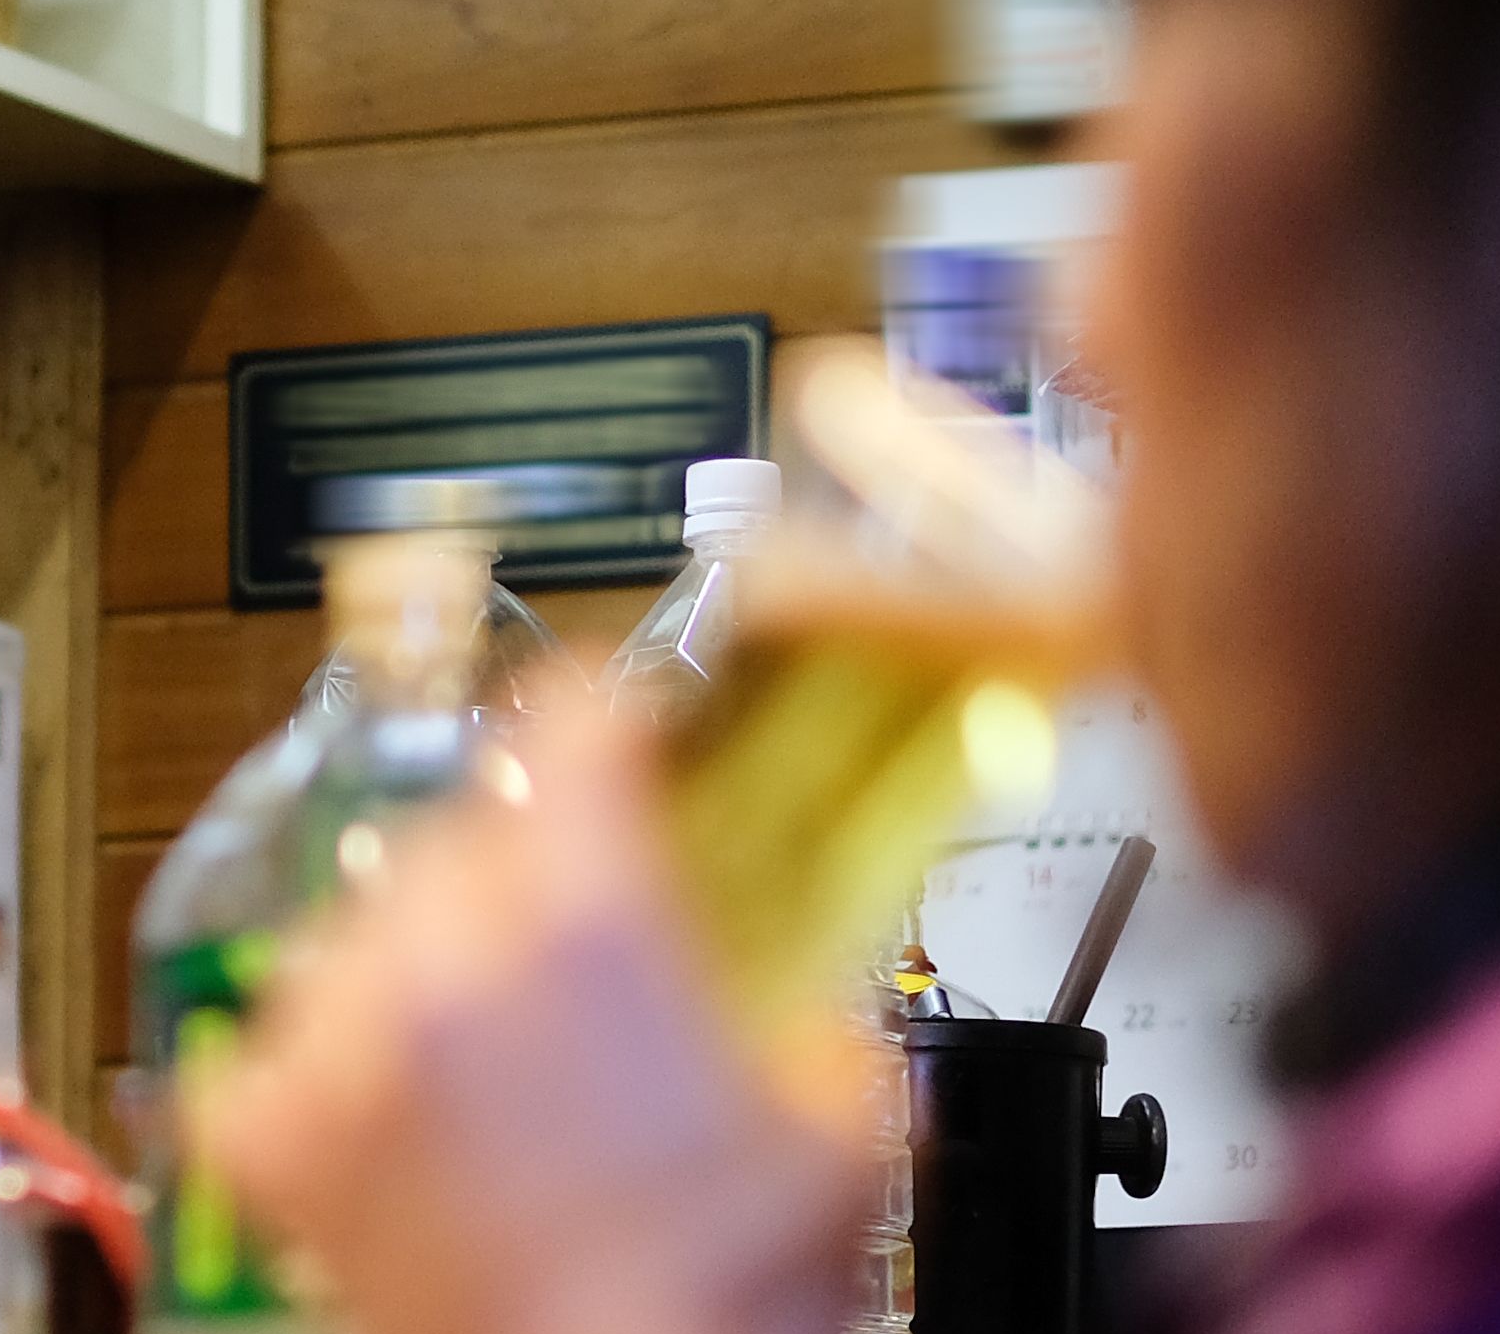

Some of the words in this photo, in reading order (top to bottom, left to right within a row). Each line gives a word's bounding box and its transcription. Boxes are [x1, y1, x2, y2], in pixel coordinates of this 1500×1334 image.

[1028, 864, 1054, 890] 14
[1124, 1003, 1155, 1029] 22
[1229, 998, 1260, 1024] 23
[1226, 1145, 1256, 1170] 30
